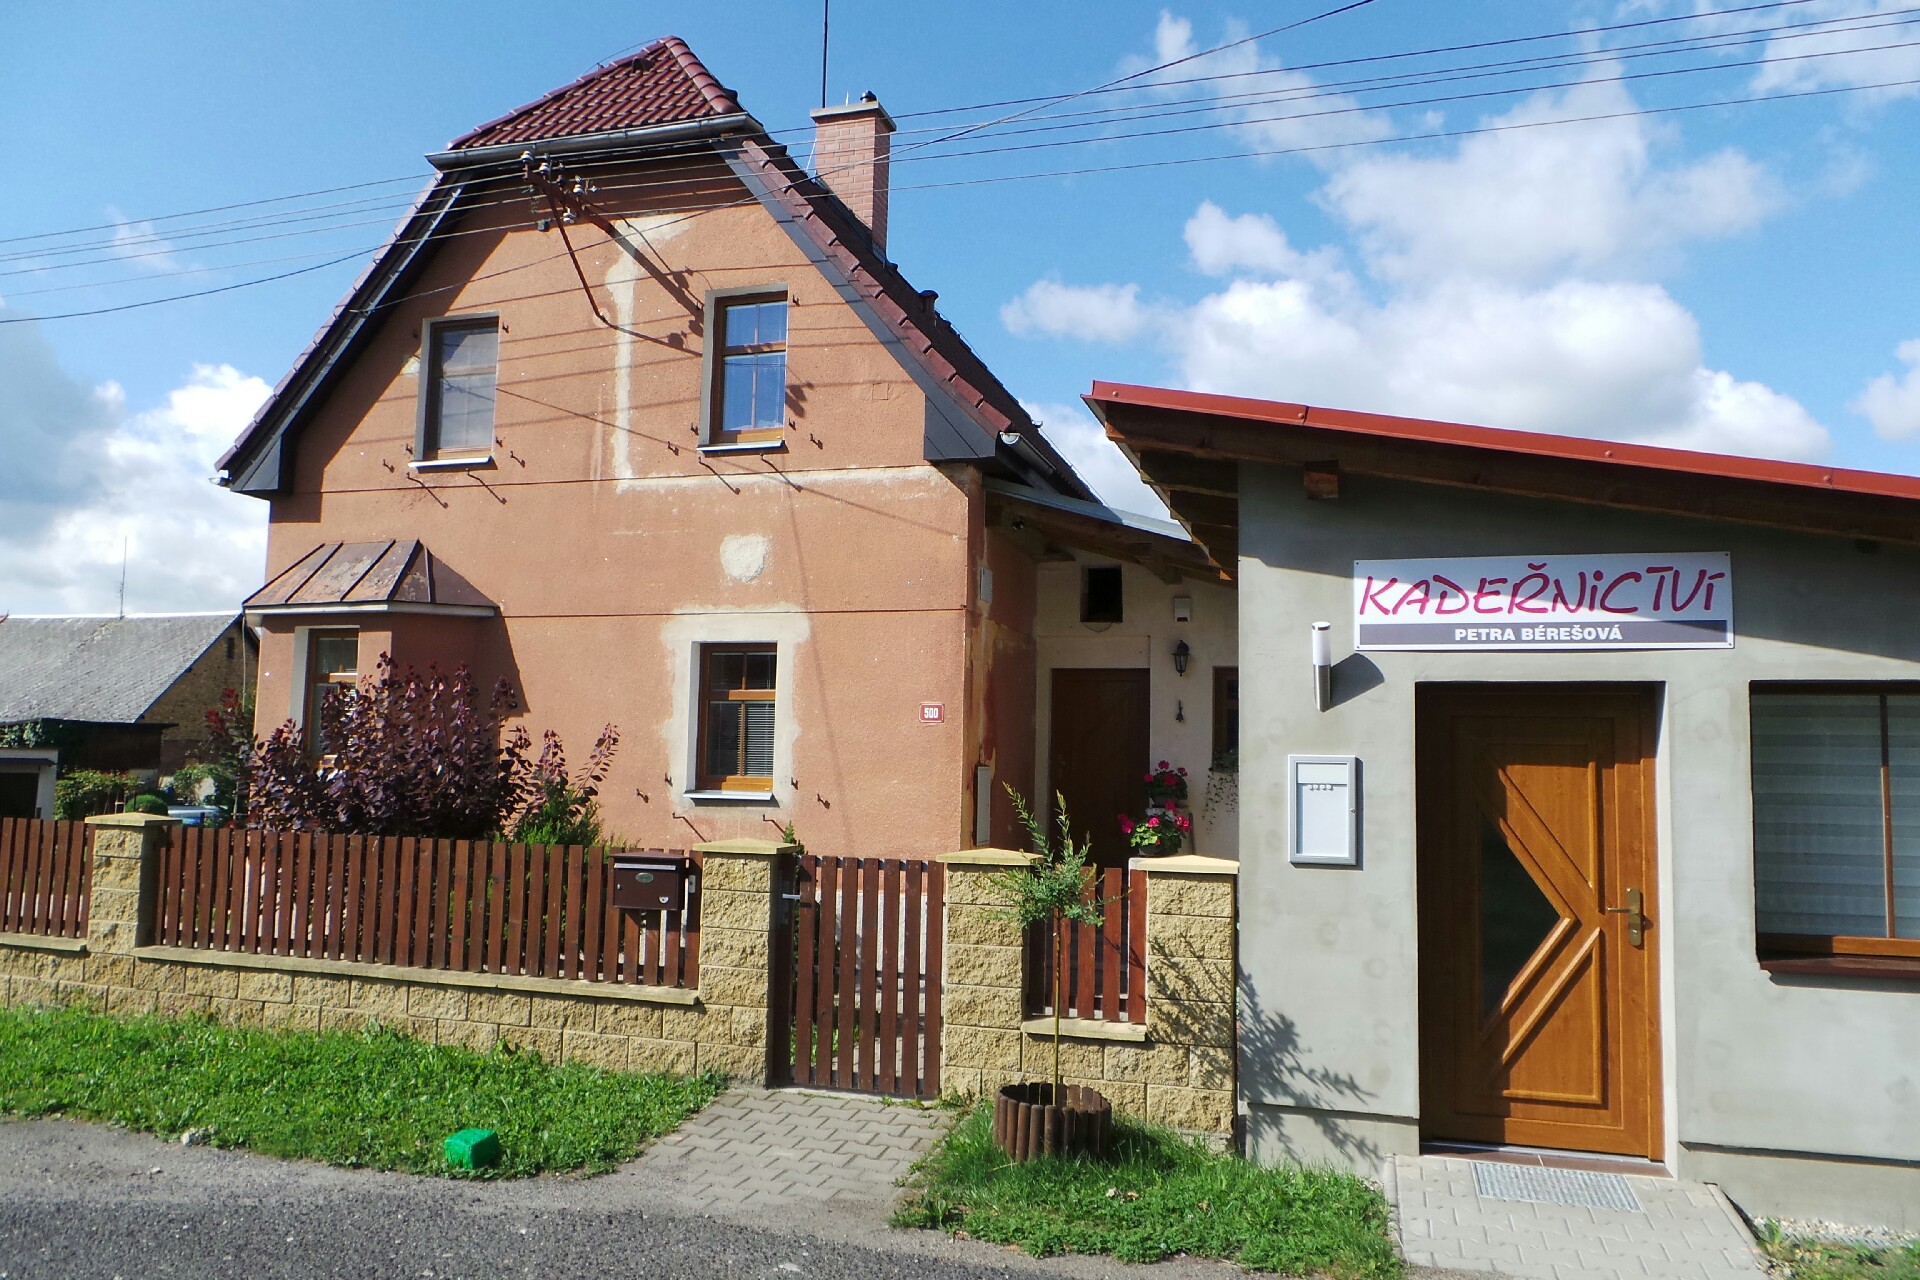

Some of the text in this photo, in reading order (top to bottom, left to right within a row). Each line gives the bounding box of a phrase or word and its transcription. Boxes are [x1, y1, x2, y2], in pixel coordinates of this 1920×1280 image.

[1455, 623, 1623, 641] PETRA BÉREŠOVÁ
[924, 707, 939, 719] 500
